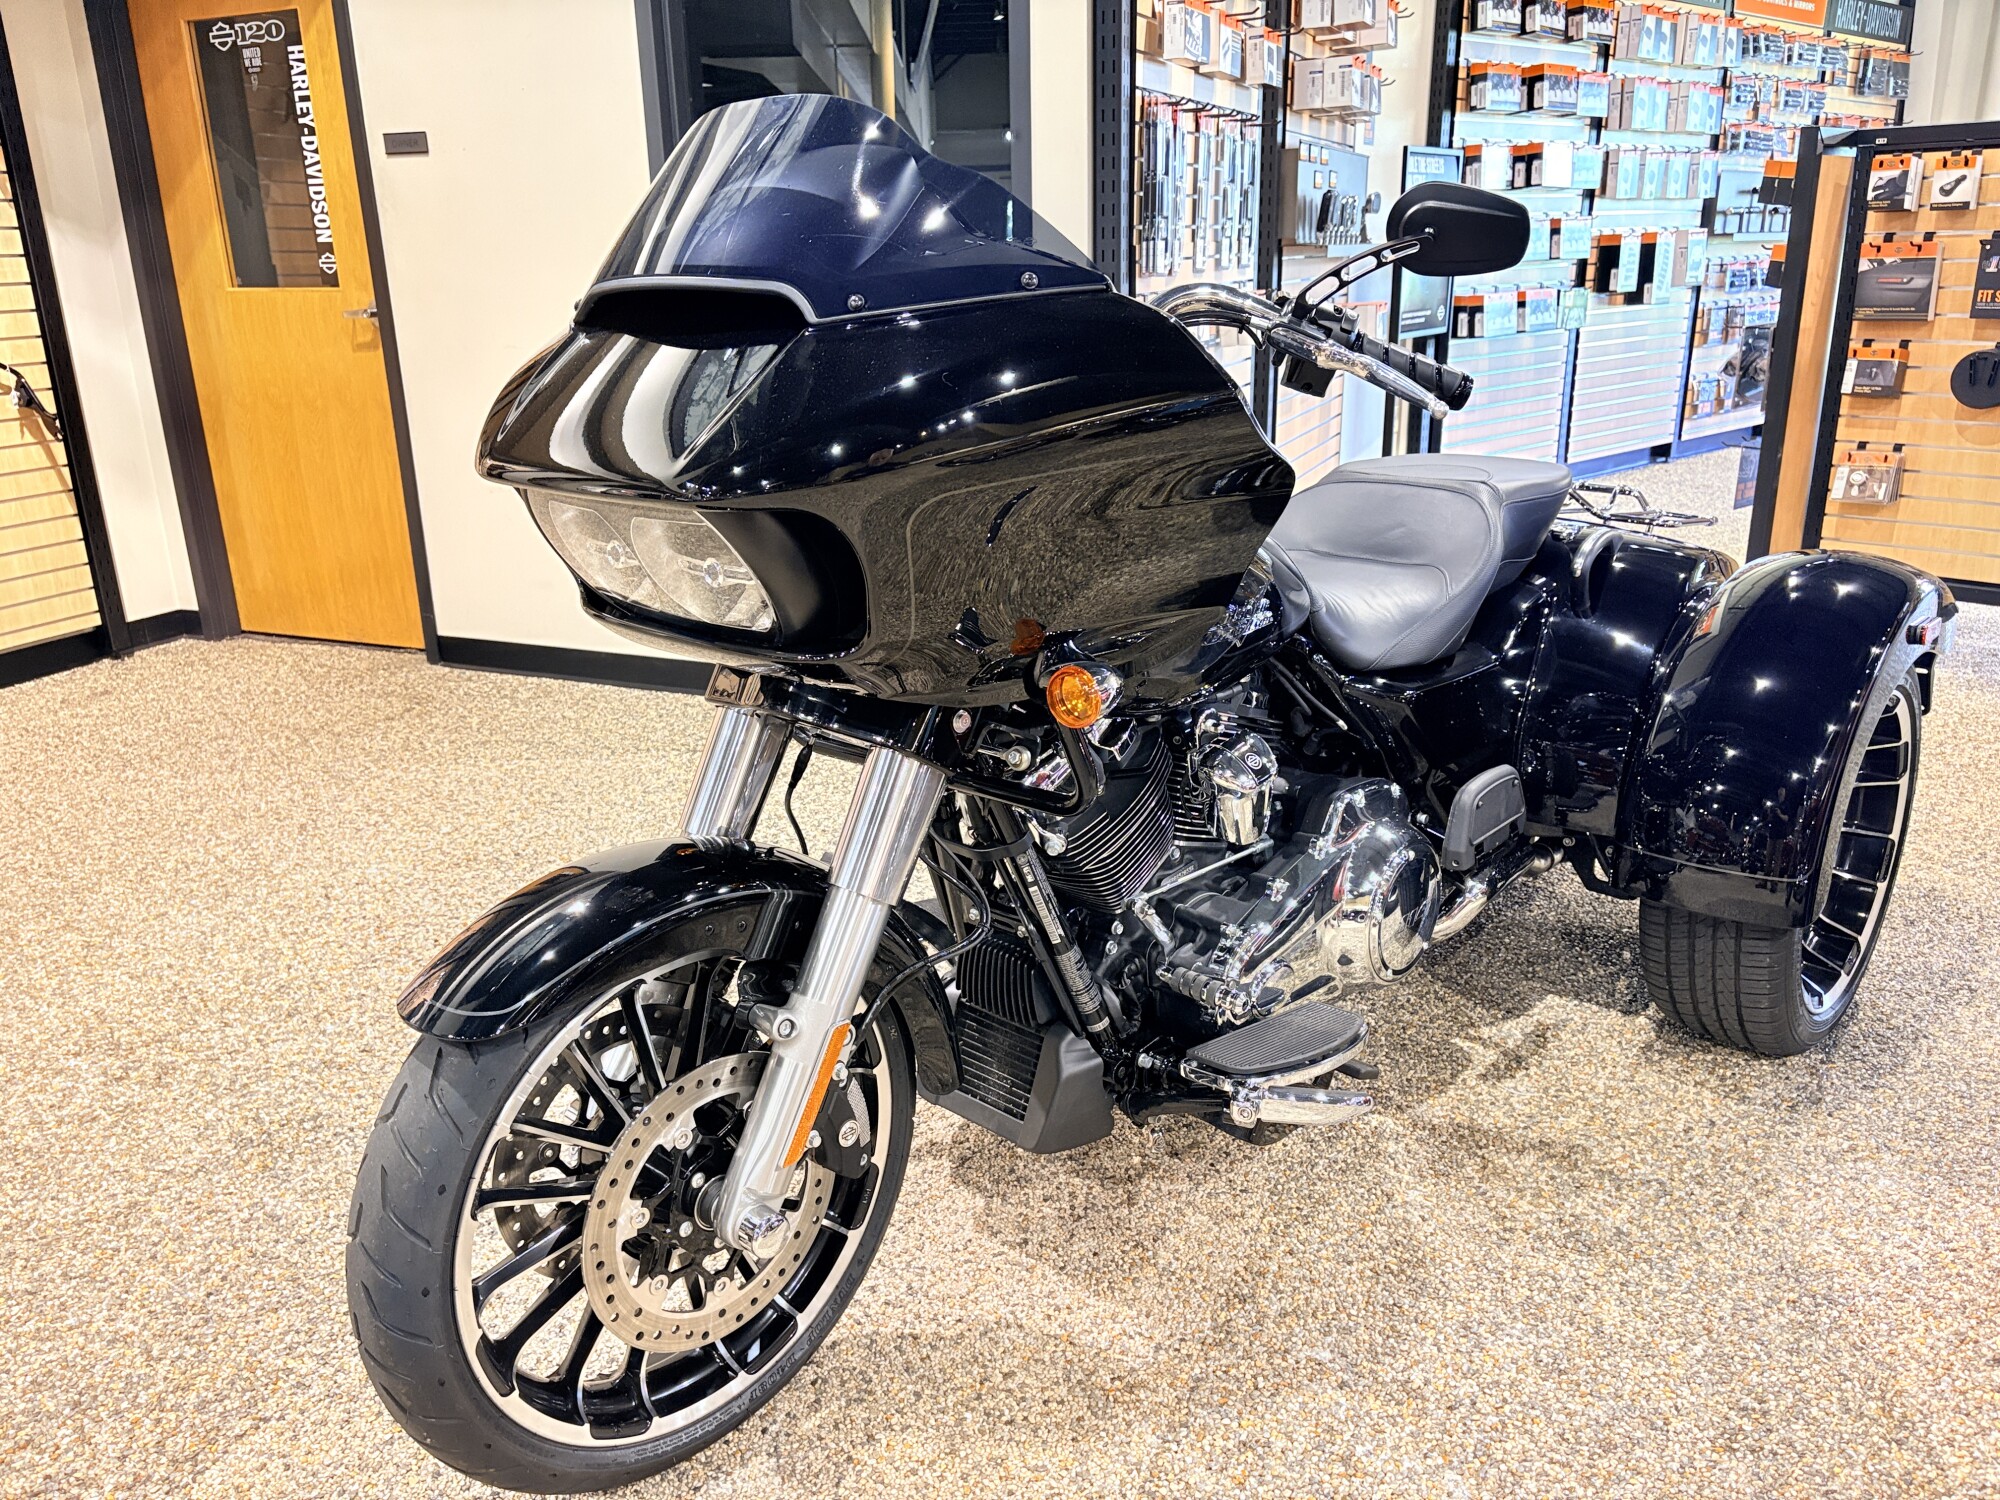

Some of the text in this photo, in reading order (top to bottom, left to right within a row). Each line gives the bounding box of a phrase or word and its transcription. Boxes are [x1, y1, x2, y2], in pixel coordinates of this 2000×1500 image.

[234, 19, 286, 45] 120
[1835, 0, 1903, 39] HARLEY-DAVIDSON
[242, 47, 262, 58] UNITED
[244, 57, 262, 67] WE RIDE
[286, 44, 333, 243] HARLEY-DAVIDSON
[1977, 289, 1994, 303] FIT
[806, 1274, 857, 1347] DUNLOP
